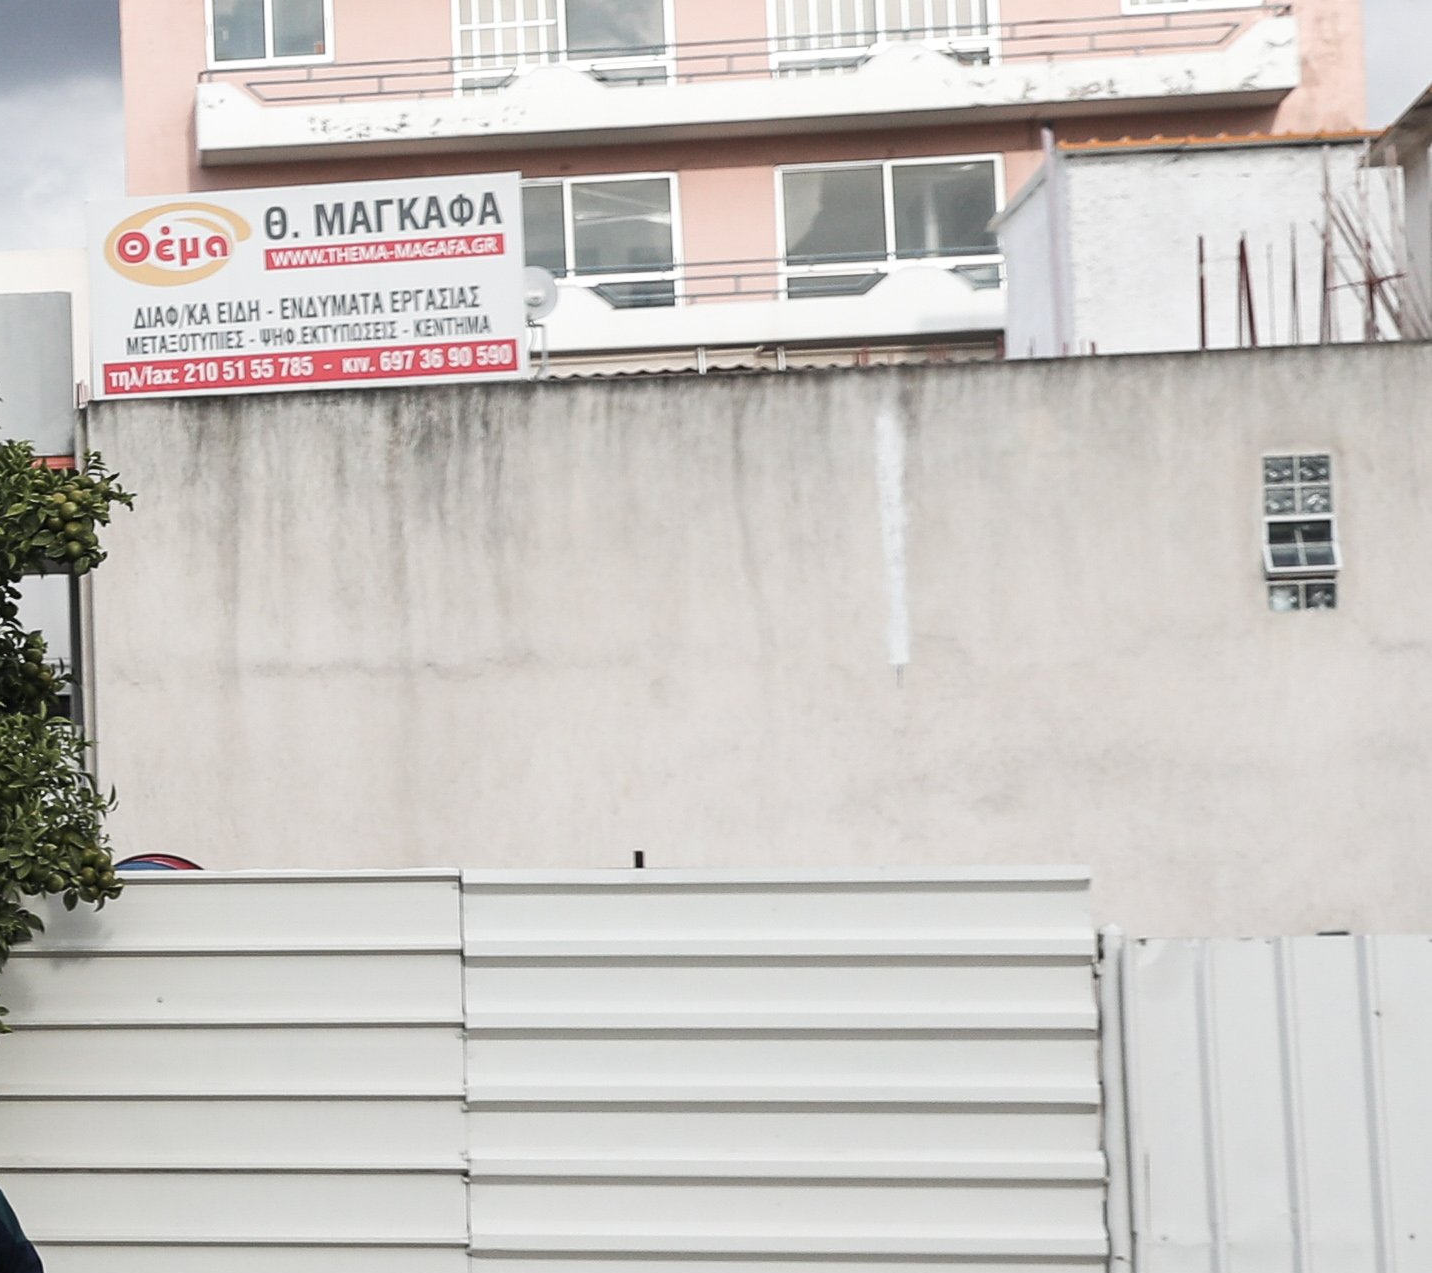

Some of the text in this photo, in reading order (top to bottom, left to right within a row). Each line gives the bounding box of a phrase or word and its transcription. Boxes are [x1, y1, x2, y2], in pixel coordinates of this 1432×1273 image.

[314, 191, 502, 238] ΜΑΓΚΑΦΑ
[271, 236, 499, 267] WWW.THEMA-MAGAFA.GR
[134, 302, 212, 330] ΔΙΑΦ/ΚΑ
[217, 299, 261, 324] ΕΙΔΗ
[280, 292, 384, 320] ΕΝΔΥΜΑΤΑ
[390, 285, 481, 313] ΕΡΓΑΣΙΑΣ
[126, 330, 245, 355] ΜΕΤΑΞΟΤΥΠΙΕΣ
[413, 314, 492, 338] ΚΕΝΤΗΜΑ
[184, 361, 219, 384] 210
[223, 359, 246, 380] 51
[250, 357, 275, 379] 55
[278, 355, 314, 377] 785
[380, 349, 416, 371] 697
[419, 347, 445, 370] 36
[448, 345, 473, 367] 90
[476, 343, 513, 366] 590
